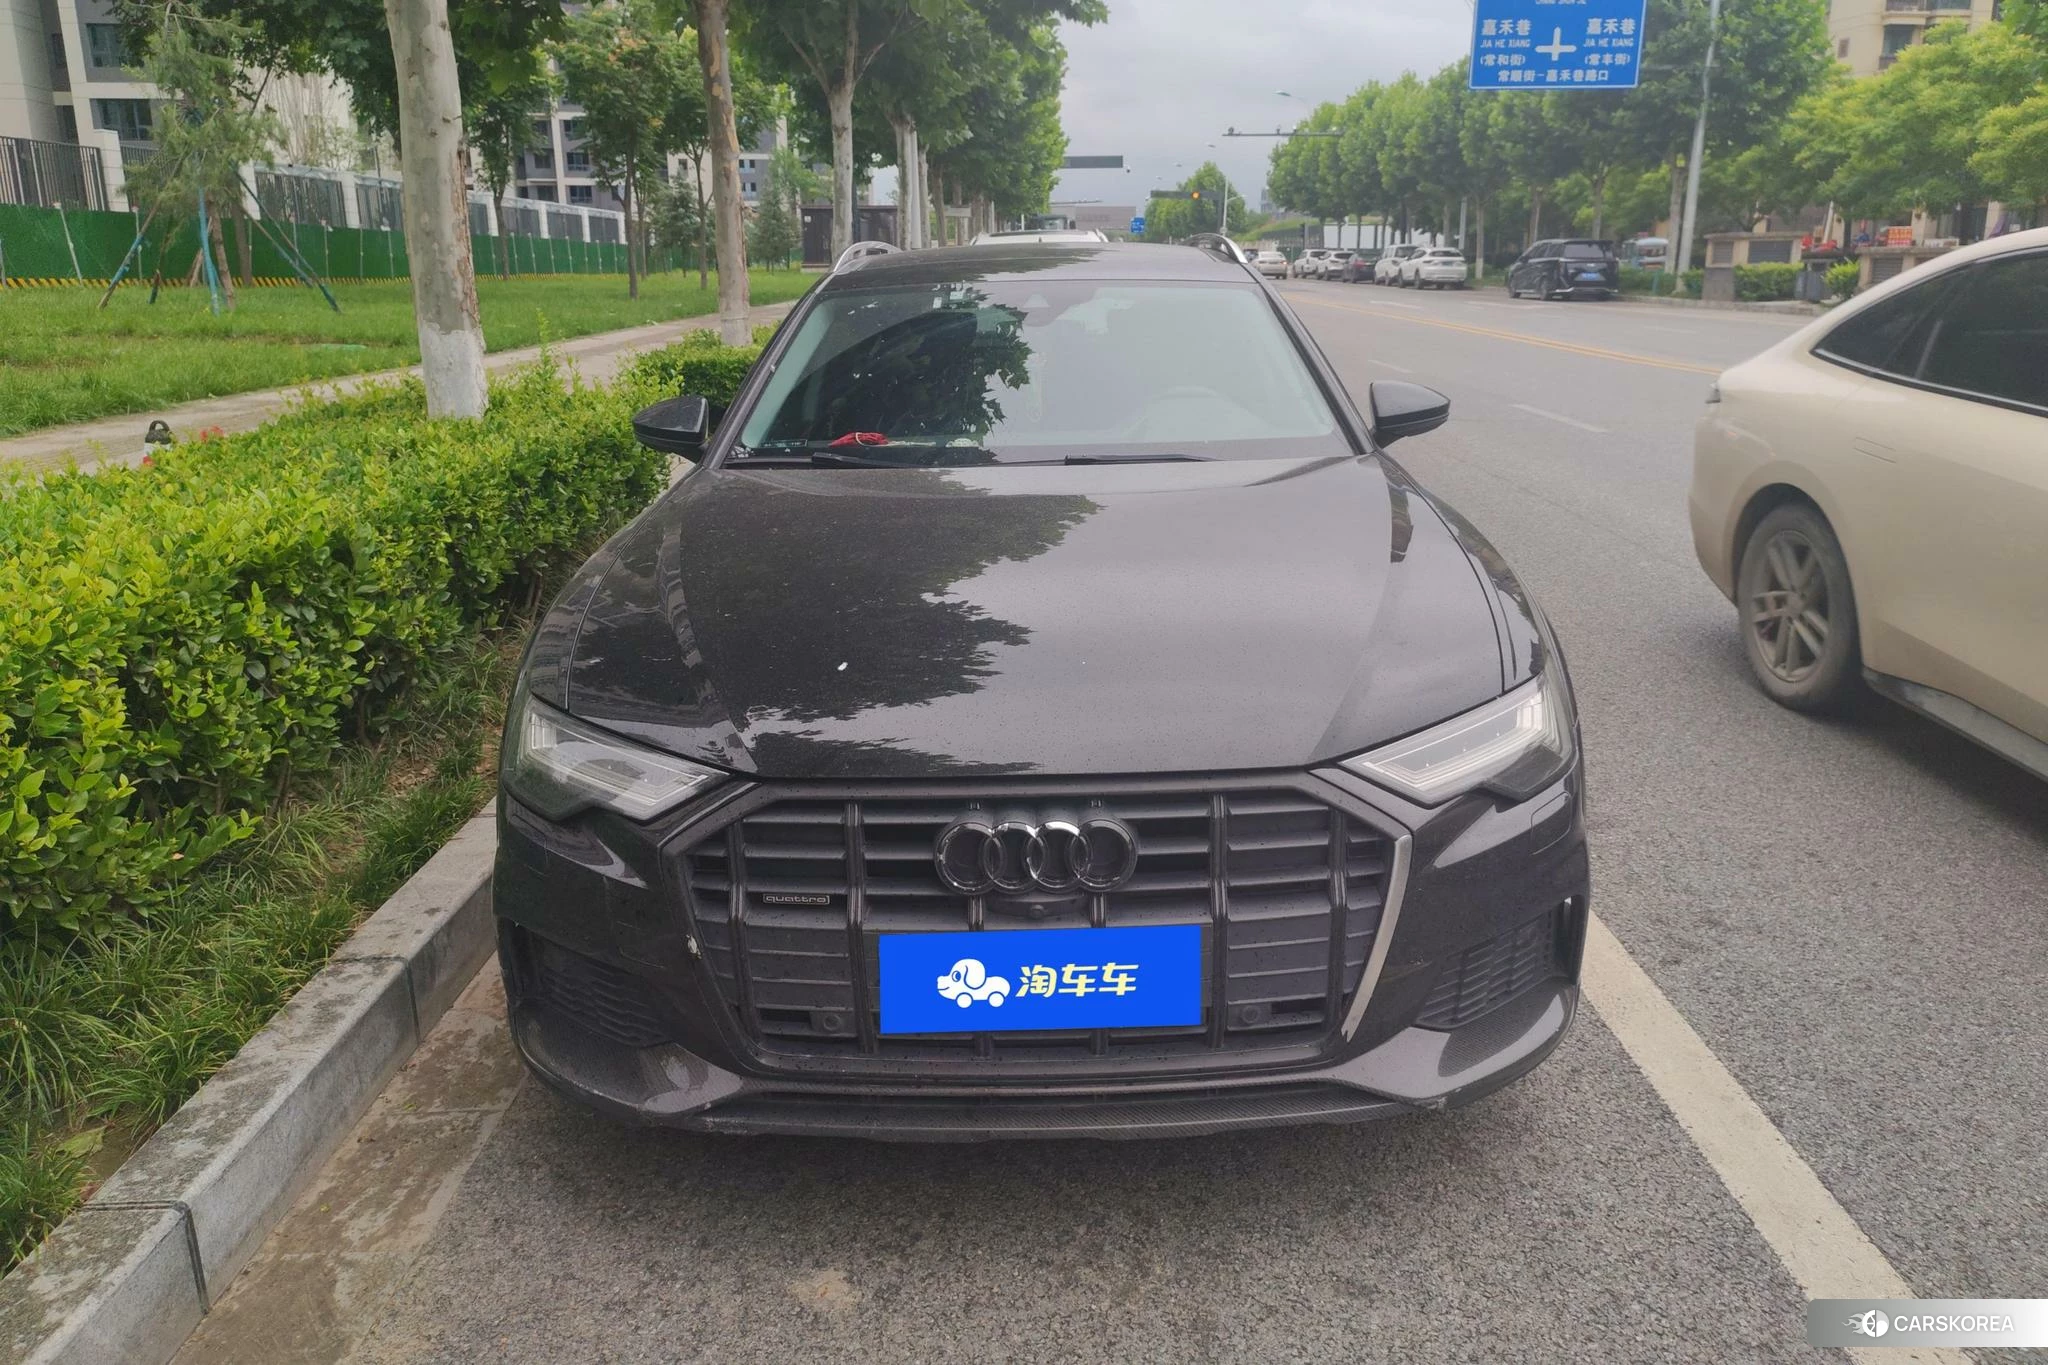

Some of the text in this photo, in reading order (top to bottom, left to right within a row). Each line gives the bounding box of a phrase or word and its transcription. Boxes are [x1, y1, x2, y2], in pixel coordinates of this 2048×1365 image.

[1482, 19, 1531, 36] 嘉禾巷
[1586, 18, 1635, 35] 嘉禾巷
[1480, 39, 1531, 48] JIA HE XIANG
[1583, 38, 1634, 47] JIA HE XIANG
[765, 895, 827, 903] quattro
